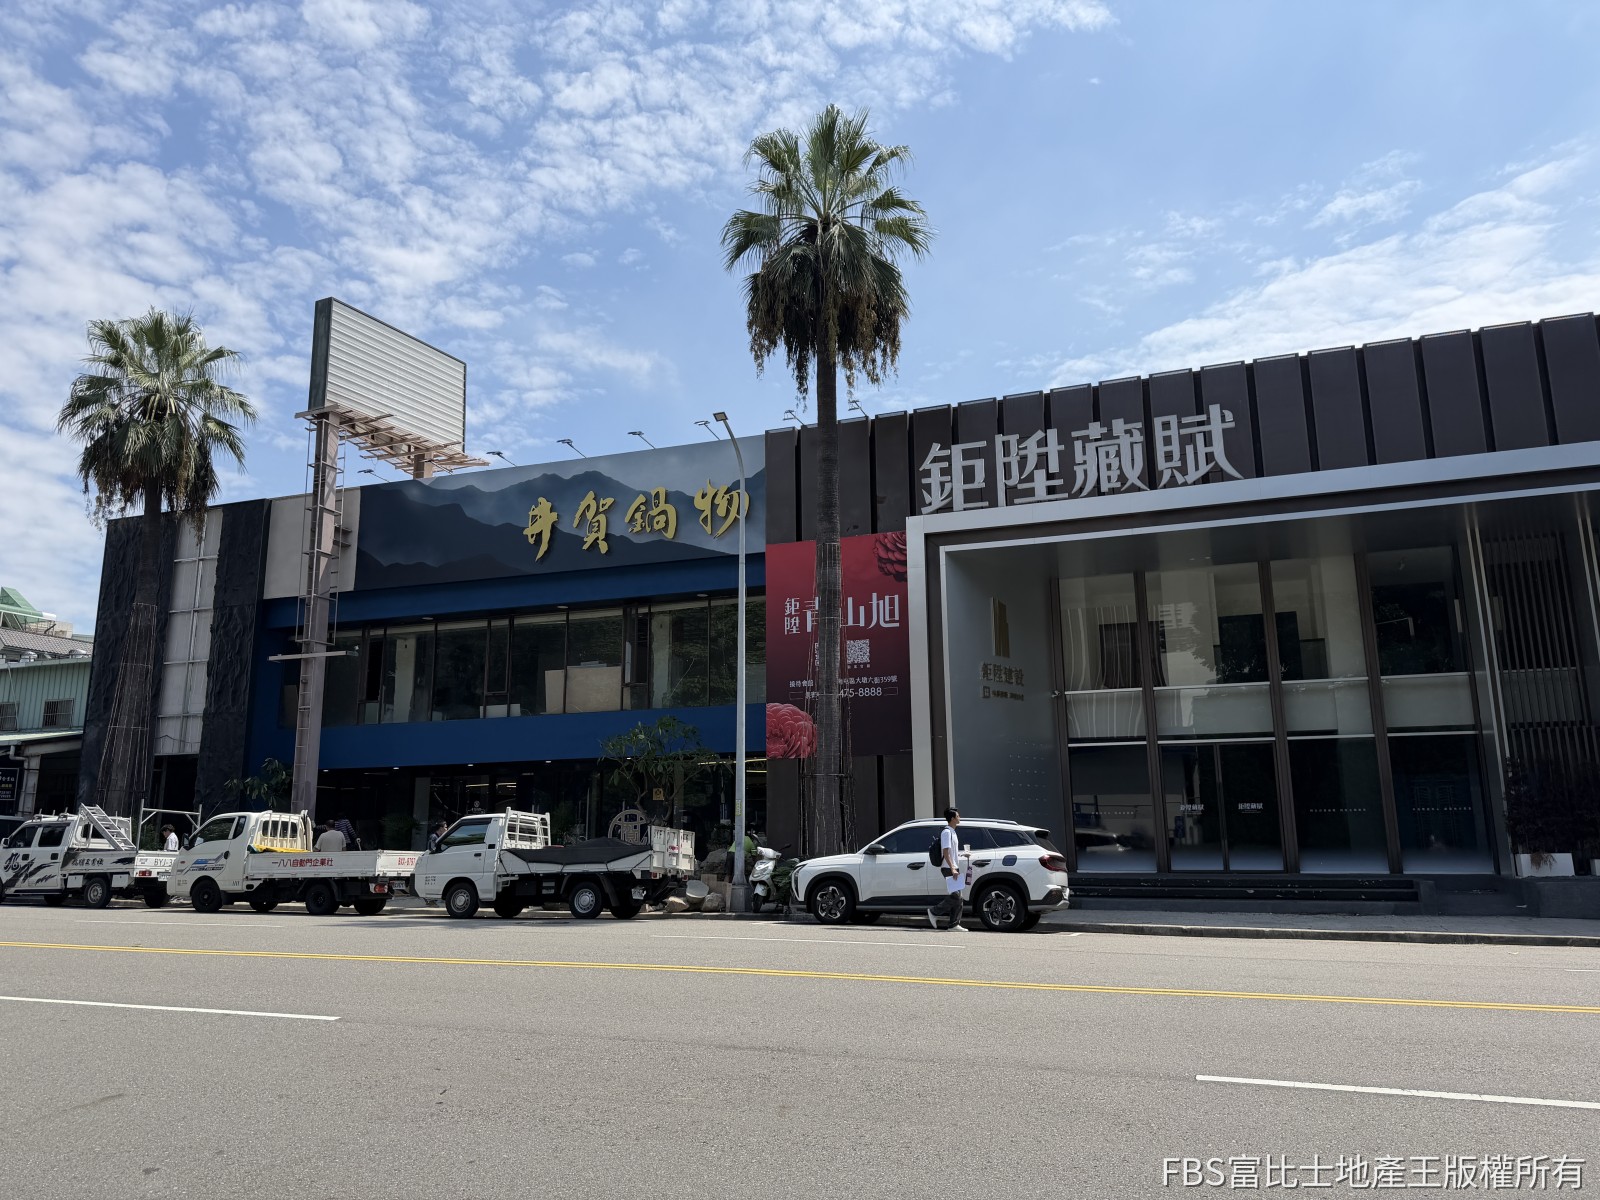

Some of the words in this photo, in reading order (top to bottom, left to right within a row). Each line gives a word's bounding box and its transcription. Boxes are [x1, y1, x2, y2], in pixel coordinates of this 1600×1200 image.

[920, 404, 1245, 514] 鉅陞藏賦
[523, 479, 750, 562] 井賀鍋物
[784, 597, 800, 635] 鉅陞
[838, 686, 883, 698] 475-8888
[271, 857, 334, 868] 一八八自動門企業社
